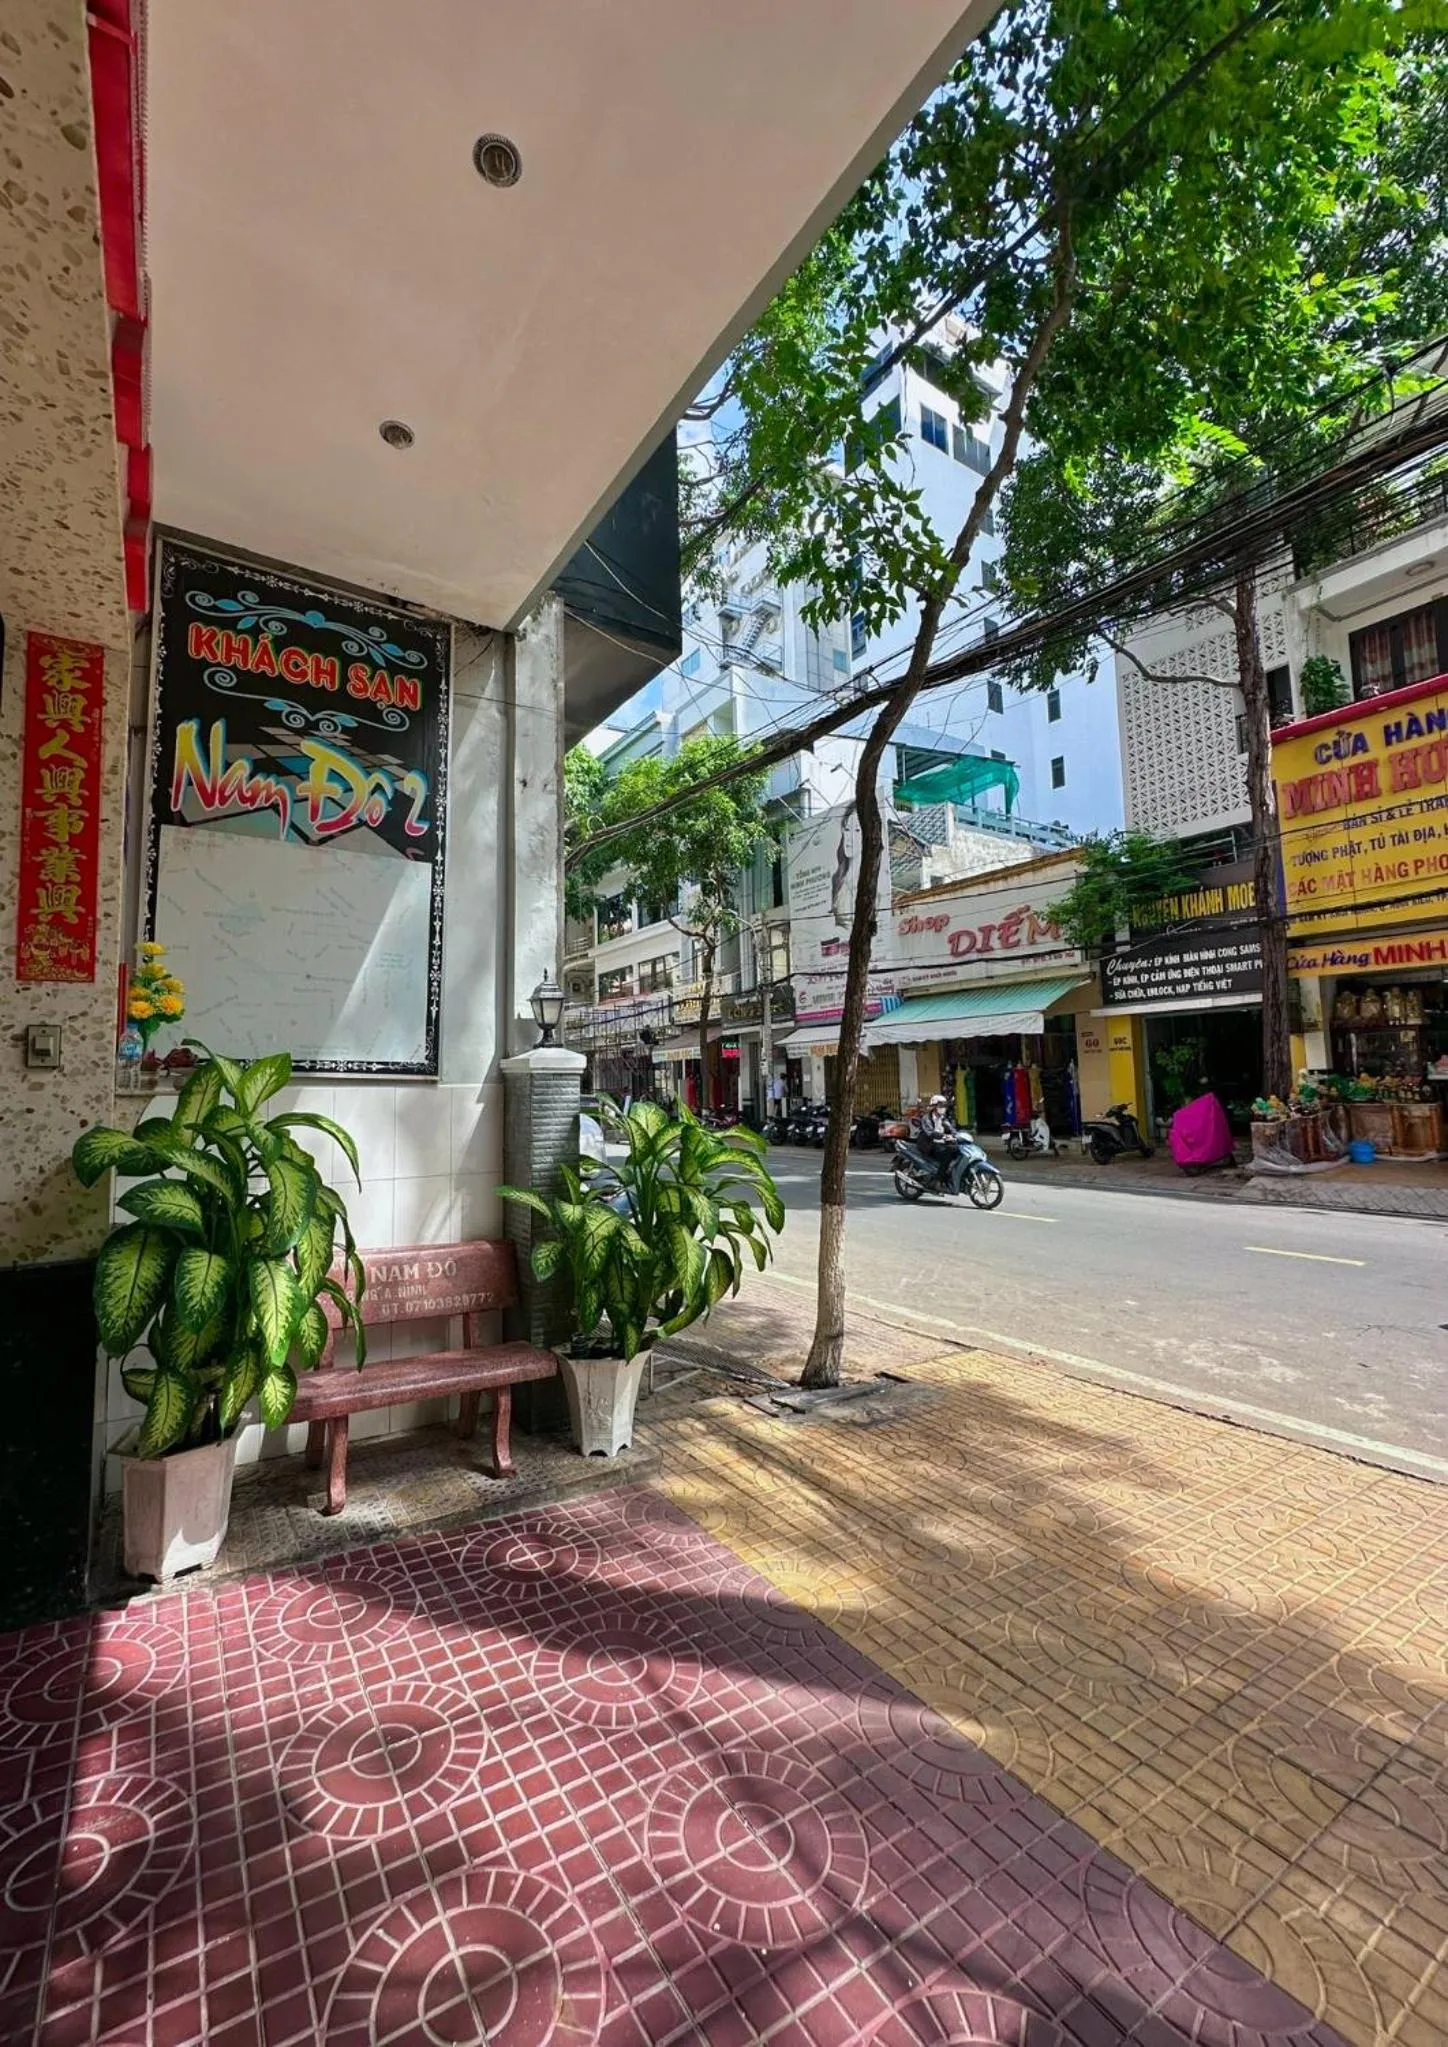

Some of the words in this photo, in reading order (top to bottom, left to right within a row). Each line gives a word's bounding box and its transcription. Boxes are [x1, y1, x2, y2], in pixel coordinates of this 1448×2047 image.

[188, 622, 339, 691] KHÁCH
[347, 662, 422, 711] SẠN
[1314, 729, 1370, 766] CỬA
[1382, 707, 1448, 747] HÀN
[170, 718, 290, 840] Nam
[297, 738, 393, 834] Đô
[403, 770, 430, 837] 2
[1282, 757, 1382, 820] MINH
[1386, 810, 1397, 821] &
[1369, 832, 1386, 850] TỦ
[1413, 826, 1441, 844] ĐỊA,
[1362, 862, 1409, 884] HÀNG
[1181, 885, 1224, 919] KHÁNH
[898, 912, 950, 936] Shop
[1321, 949, 1371, 968] Hàng
[1373, 938, 1447, 966] MINH
[370, 1262, 420, 1283] NAM
[426, 1258, 459, 1279] ĐÔ
